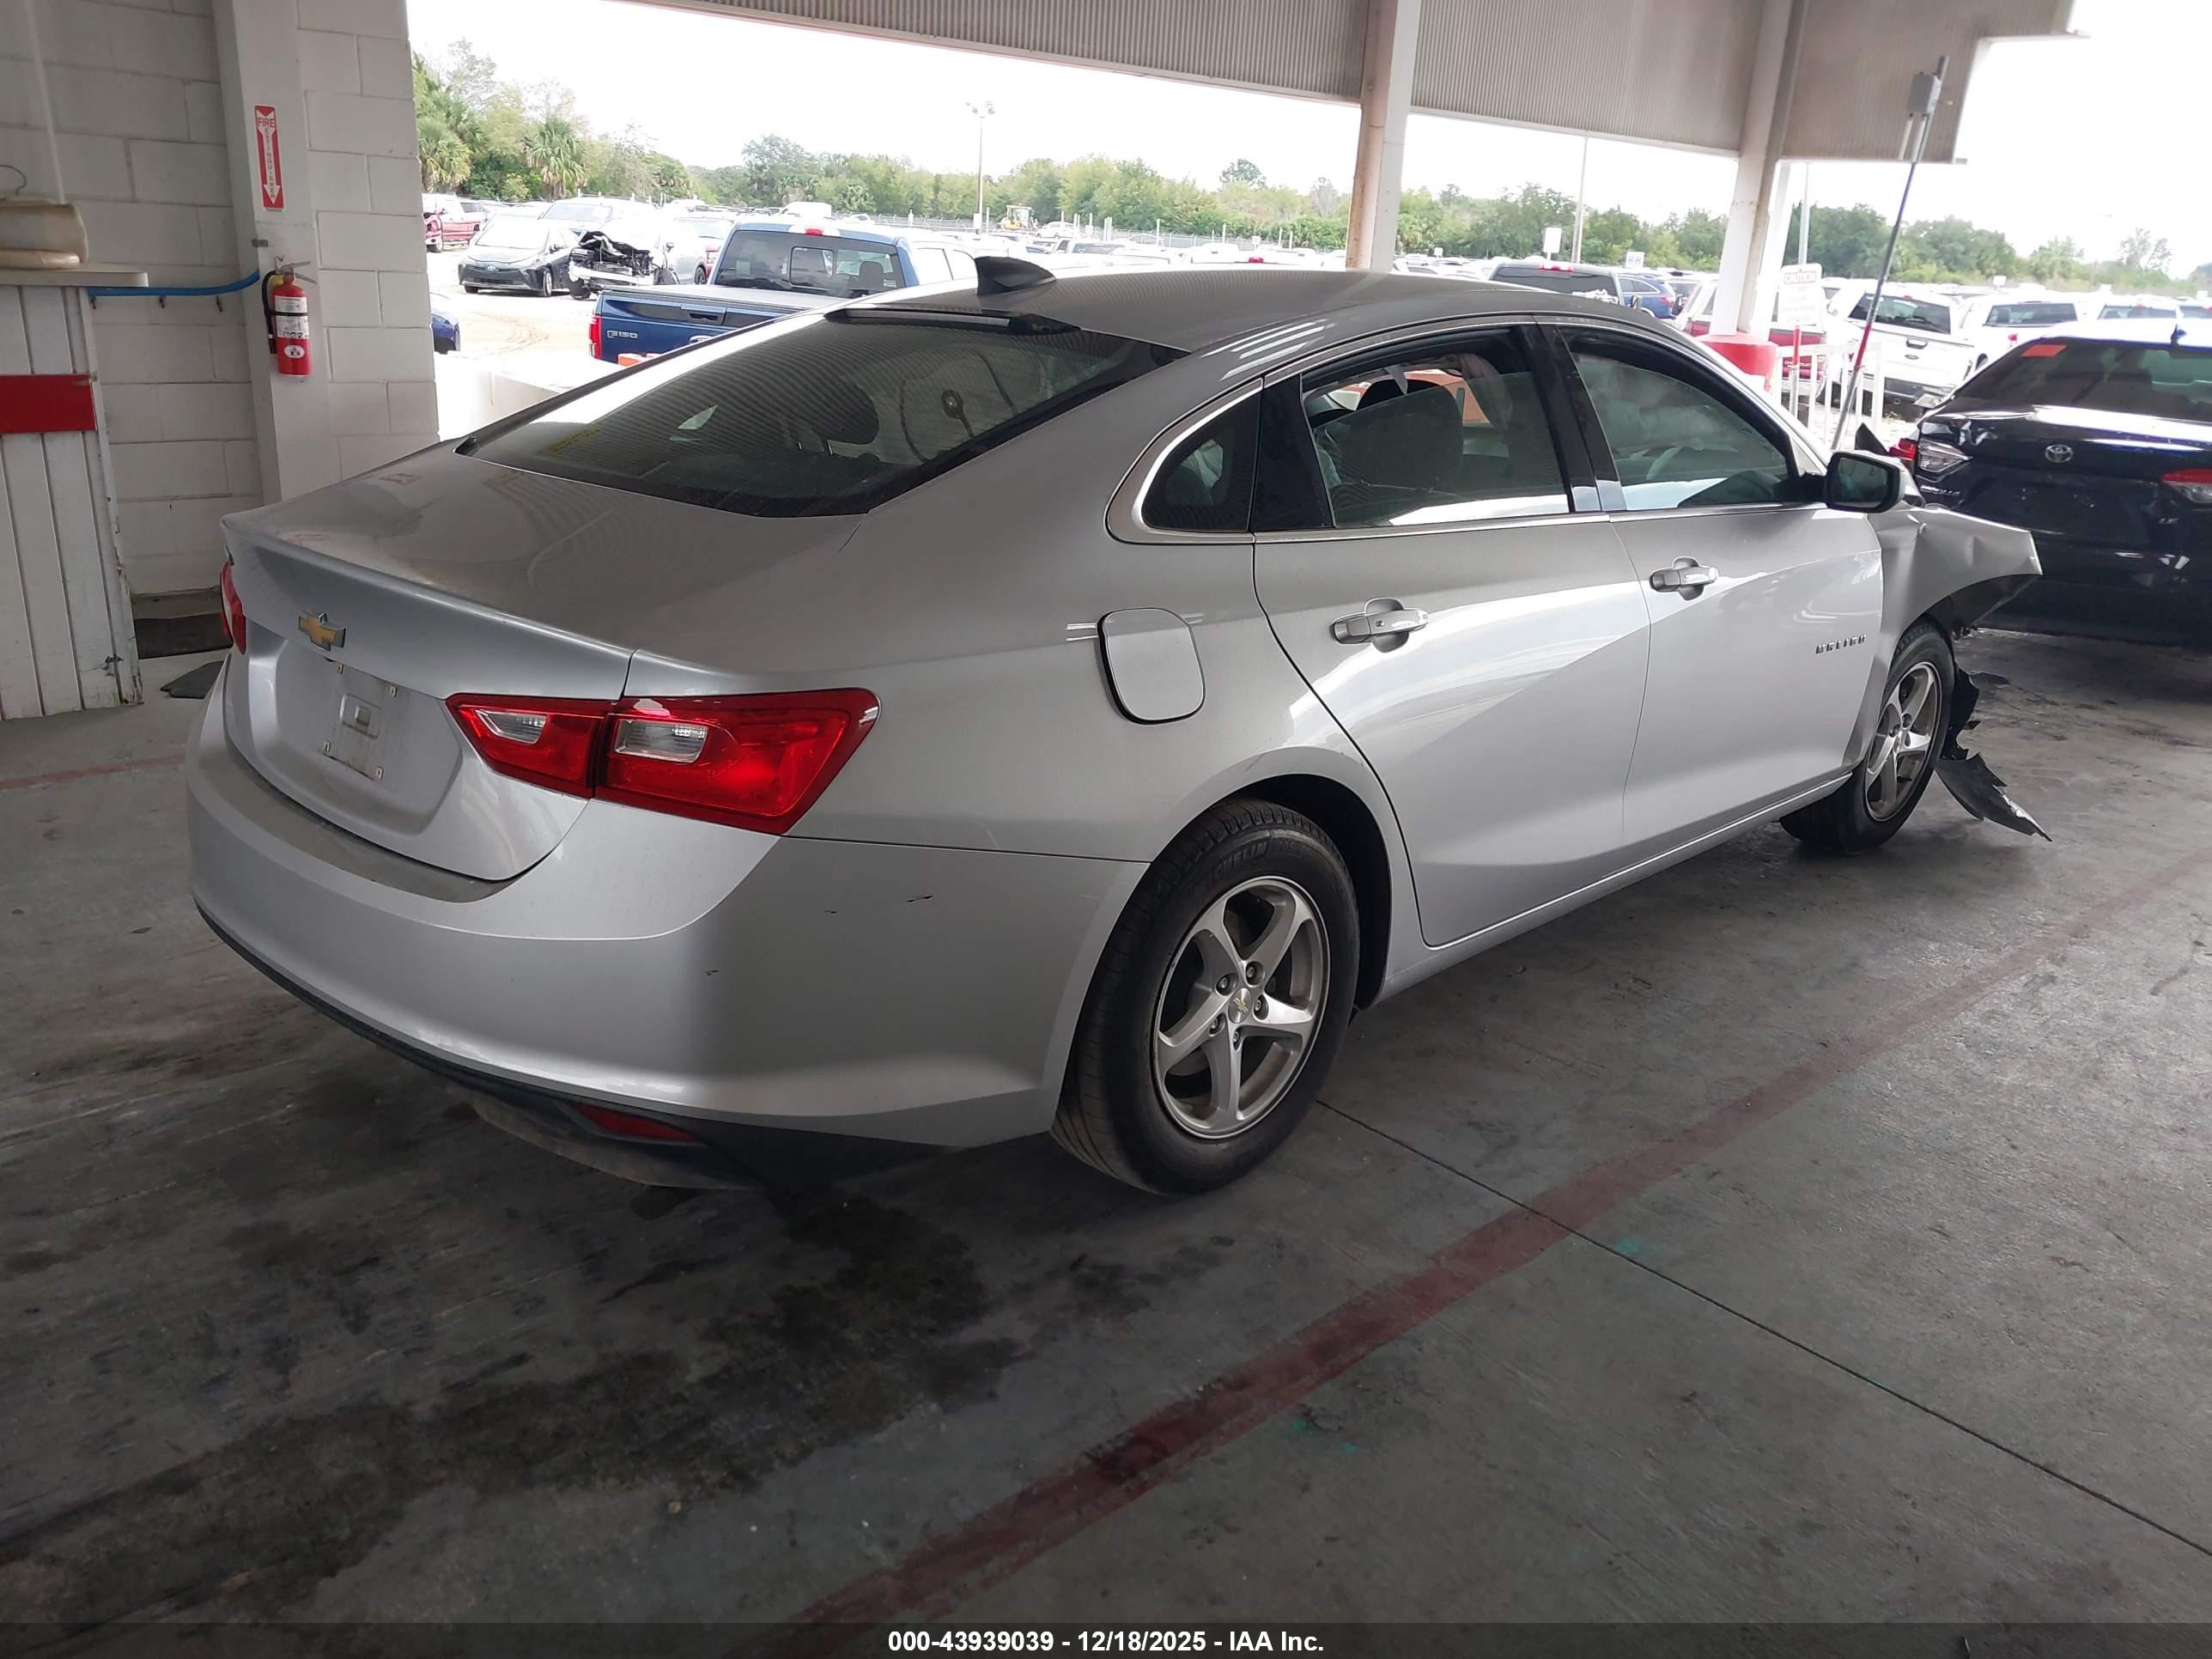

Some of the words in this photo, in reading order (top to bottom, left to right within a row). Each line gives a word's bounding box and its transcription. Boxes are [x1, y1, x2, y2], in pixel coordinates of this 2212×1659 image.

[257, 117, 276, 128] FIRE
[264, 128, 276, 199] EXTINGUISHER
[1815, 634, 1867, 654] MALIBU
